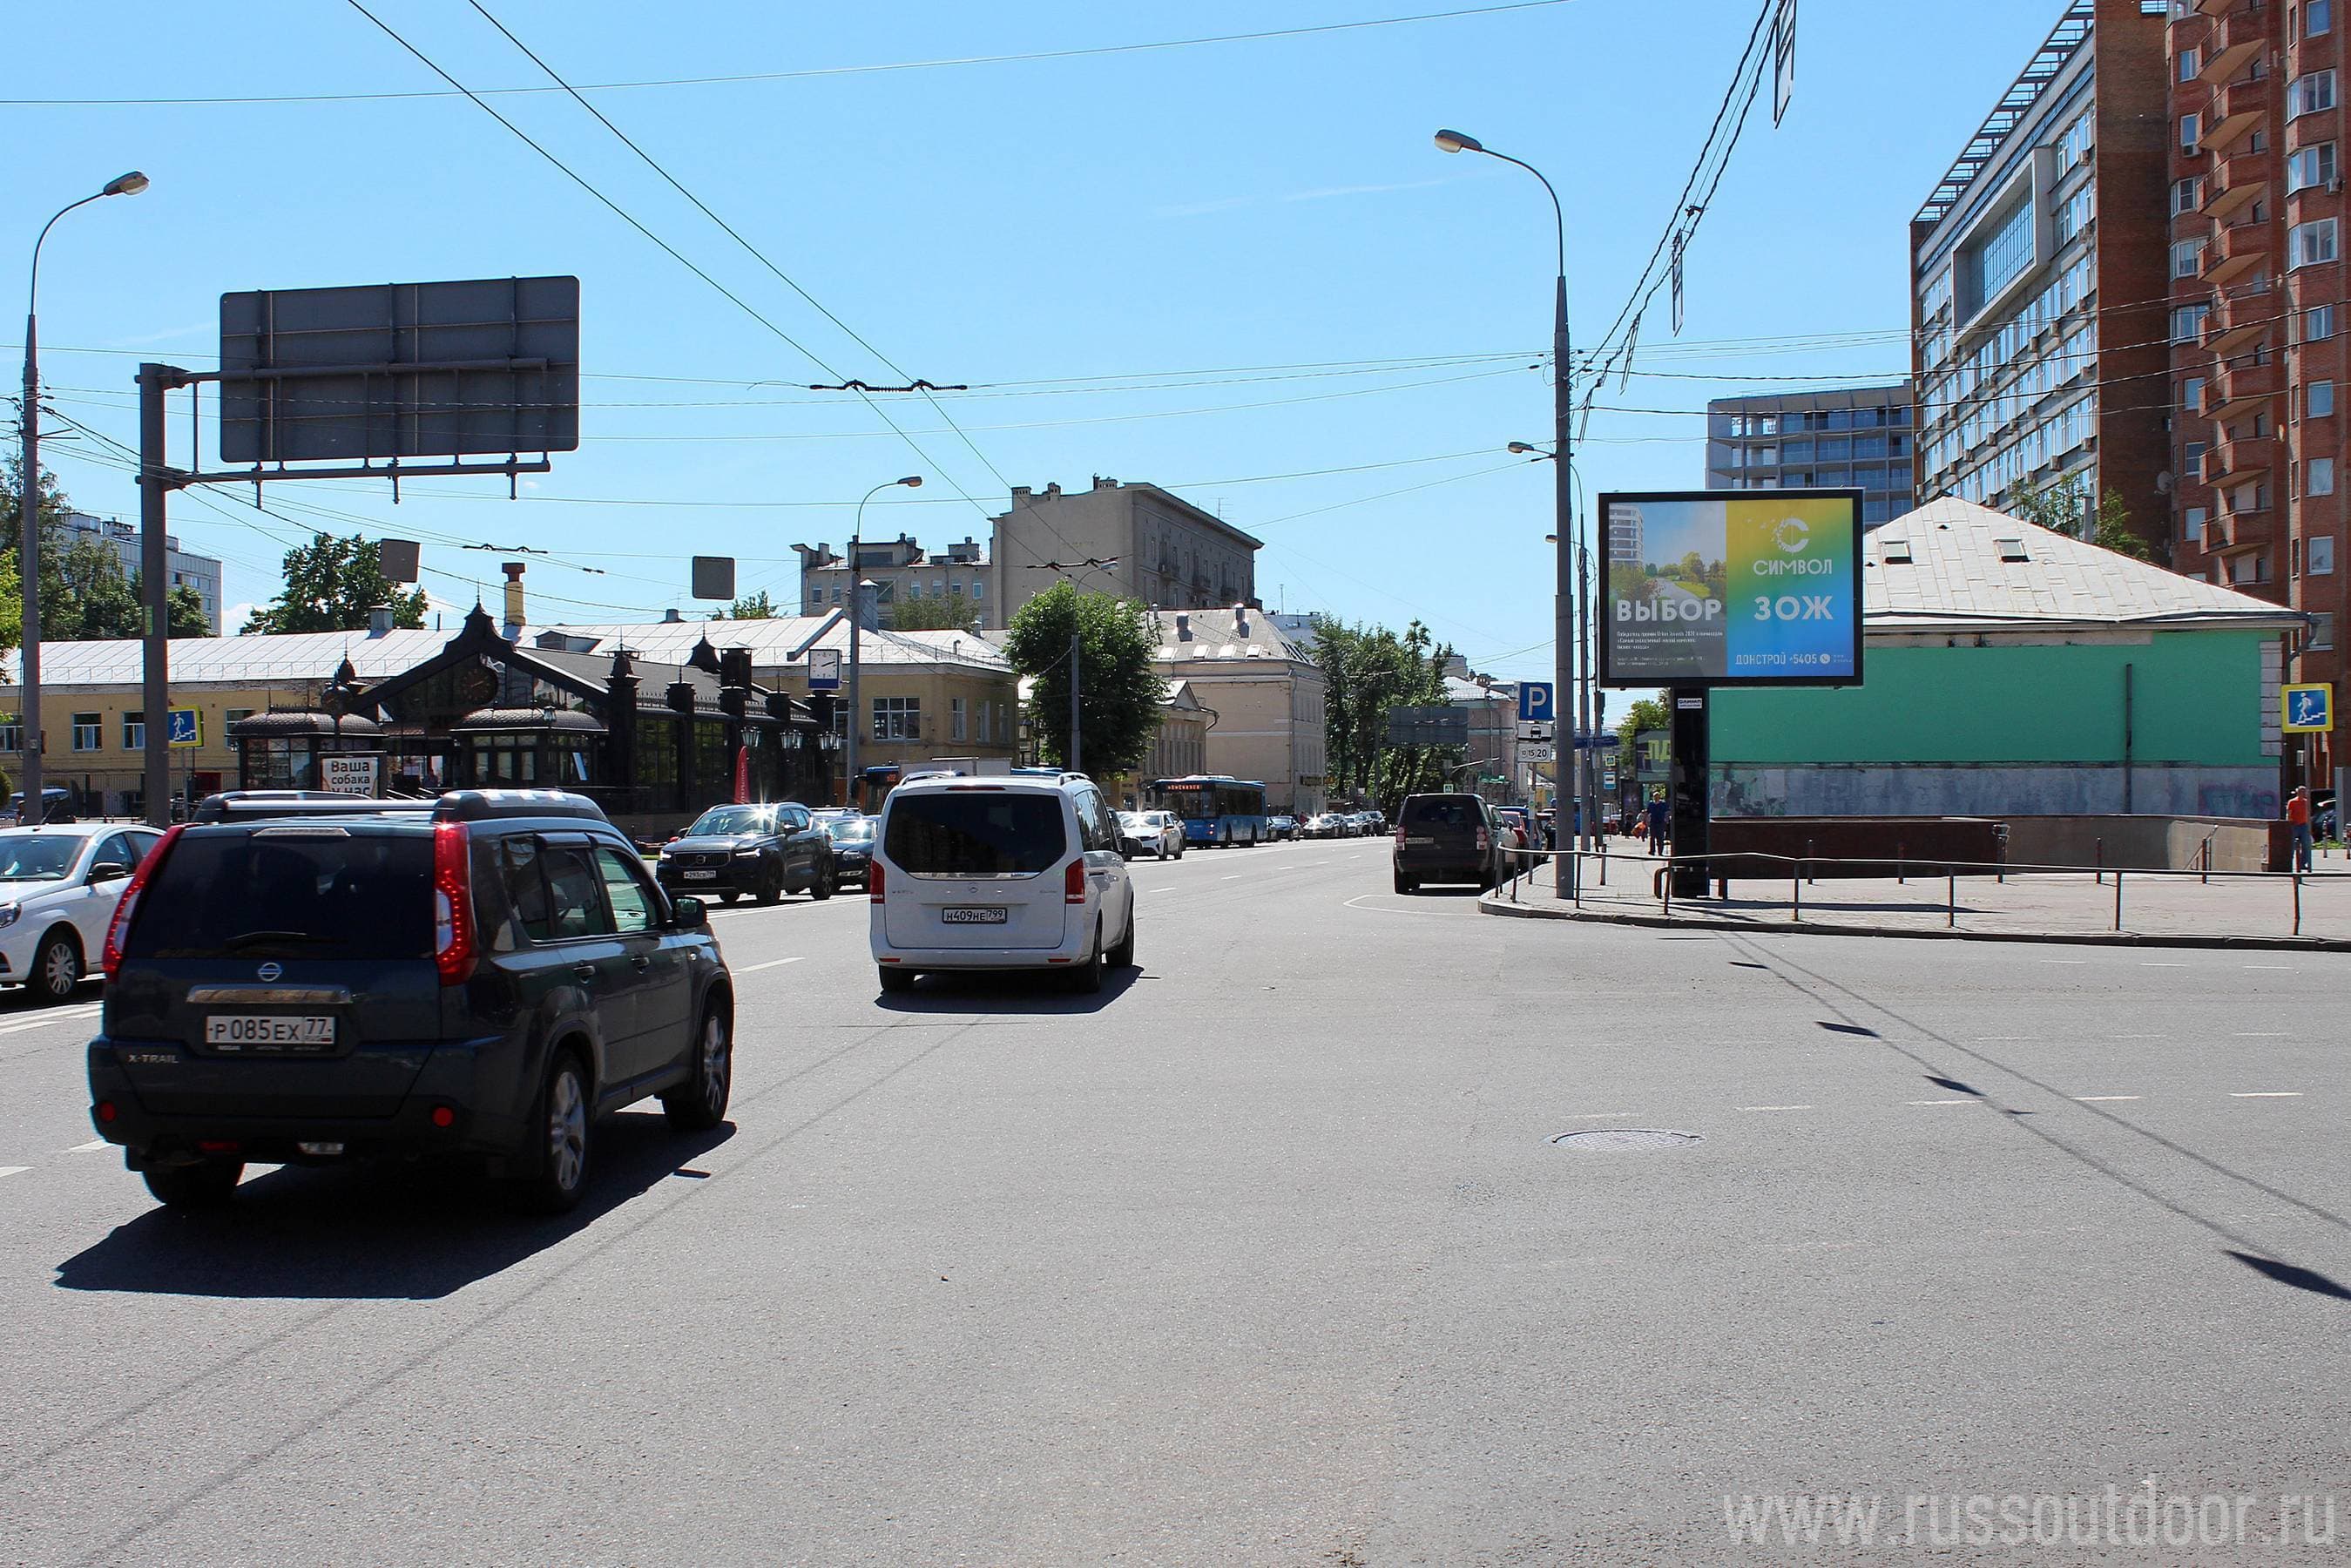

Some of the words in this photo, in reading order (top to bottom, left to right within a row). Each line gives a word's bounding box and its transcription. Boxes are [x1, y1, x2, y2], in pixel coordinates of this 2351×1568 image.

[1753, 558, 1833, 576] СИМВОЛ
[1616, 598, 1723, 623] ВЫБОР
[1753, 595, 1834, 621] ЗОЖ
[1735, 652, 1787, 666] ДОНСТРОЙ
[1537, 748, 1547, 758] 20
[331, 760, 370, 773] Ваша
[331, 774, 370, 785] собака
[127, 1054, 179, 1064] X-TRAIL
